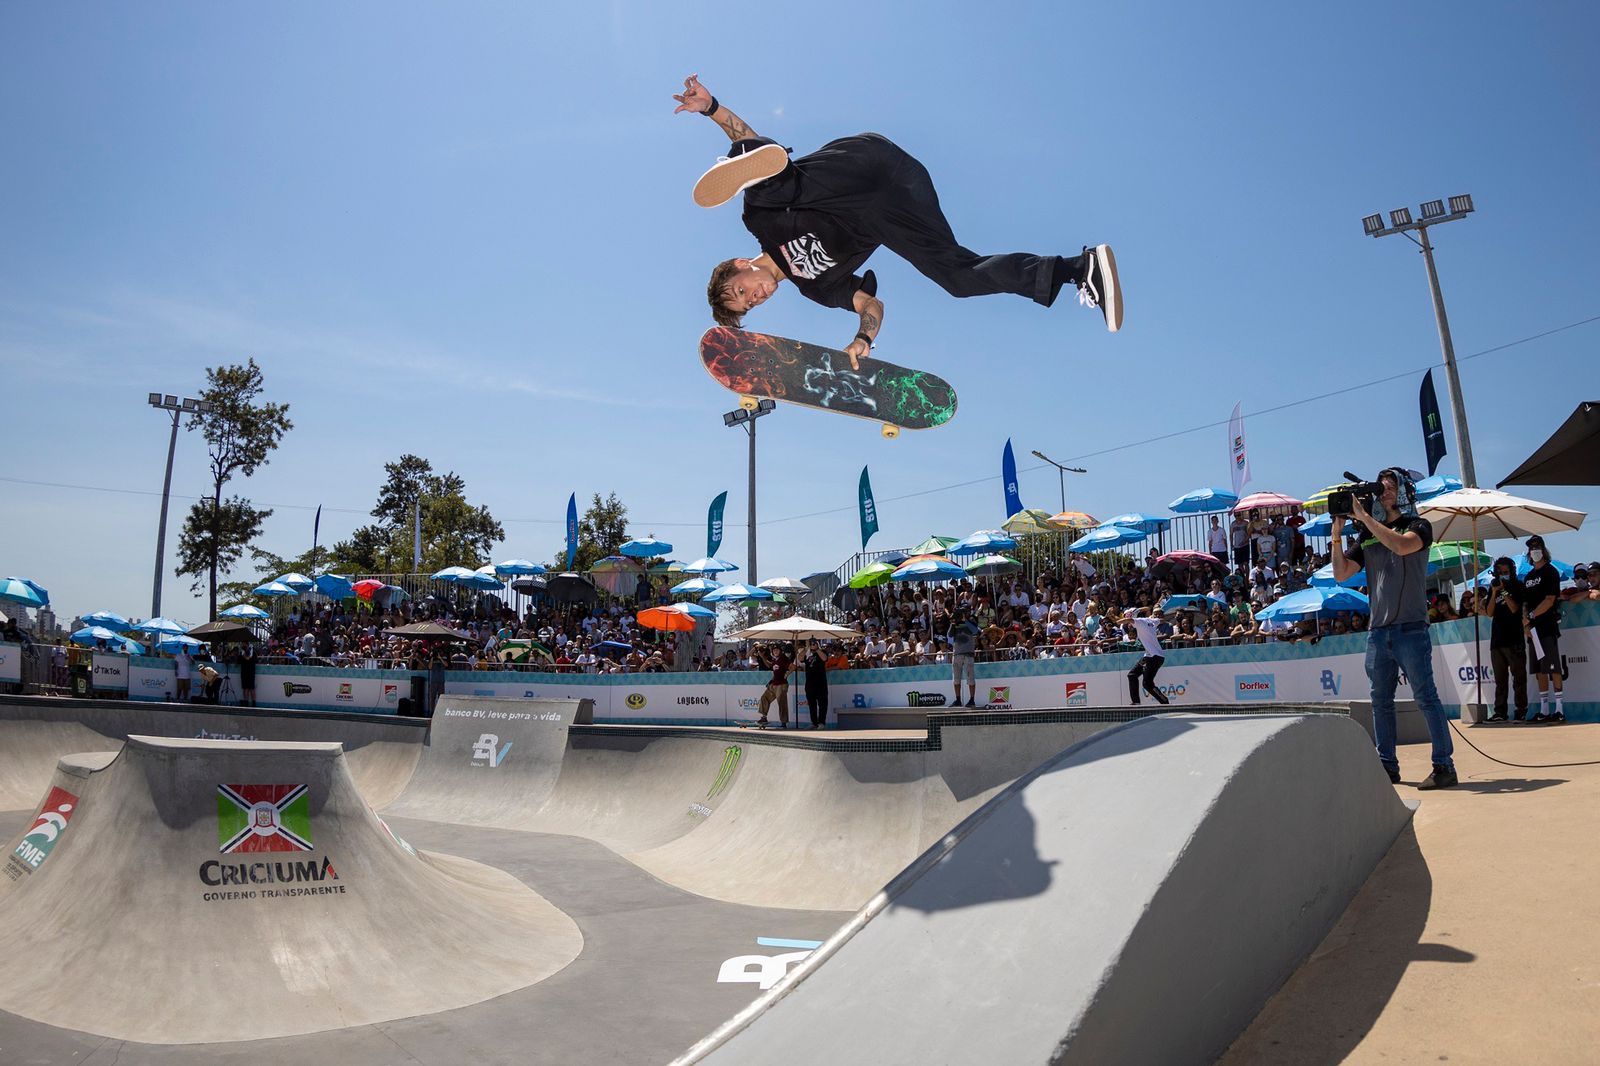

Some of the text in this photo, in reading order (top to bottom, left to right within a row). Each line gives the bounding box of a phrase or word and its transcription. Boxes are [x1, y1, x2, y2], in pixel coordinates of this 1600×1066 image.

[101, 667, 121, 675] TikTok
[1239, 682, 1270, 690] Dorflex
[677, 697, 710, 706] LAYBACK
[445, 709, 471, 717] banco
[473, 711, 486, 719] BV,
[488, 711, 507, 720] leve
[540, 711, 561, 721] vida
[15, 839, 47, 868] FME
[198, 856, 340, 887] CRICIUMA
[203, 885, 346, 902] GOVERNO TRANSPARENTE
